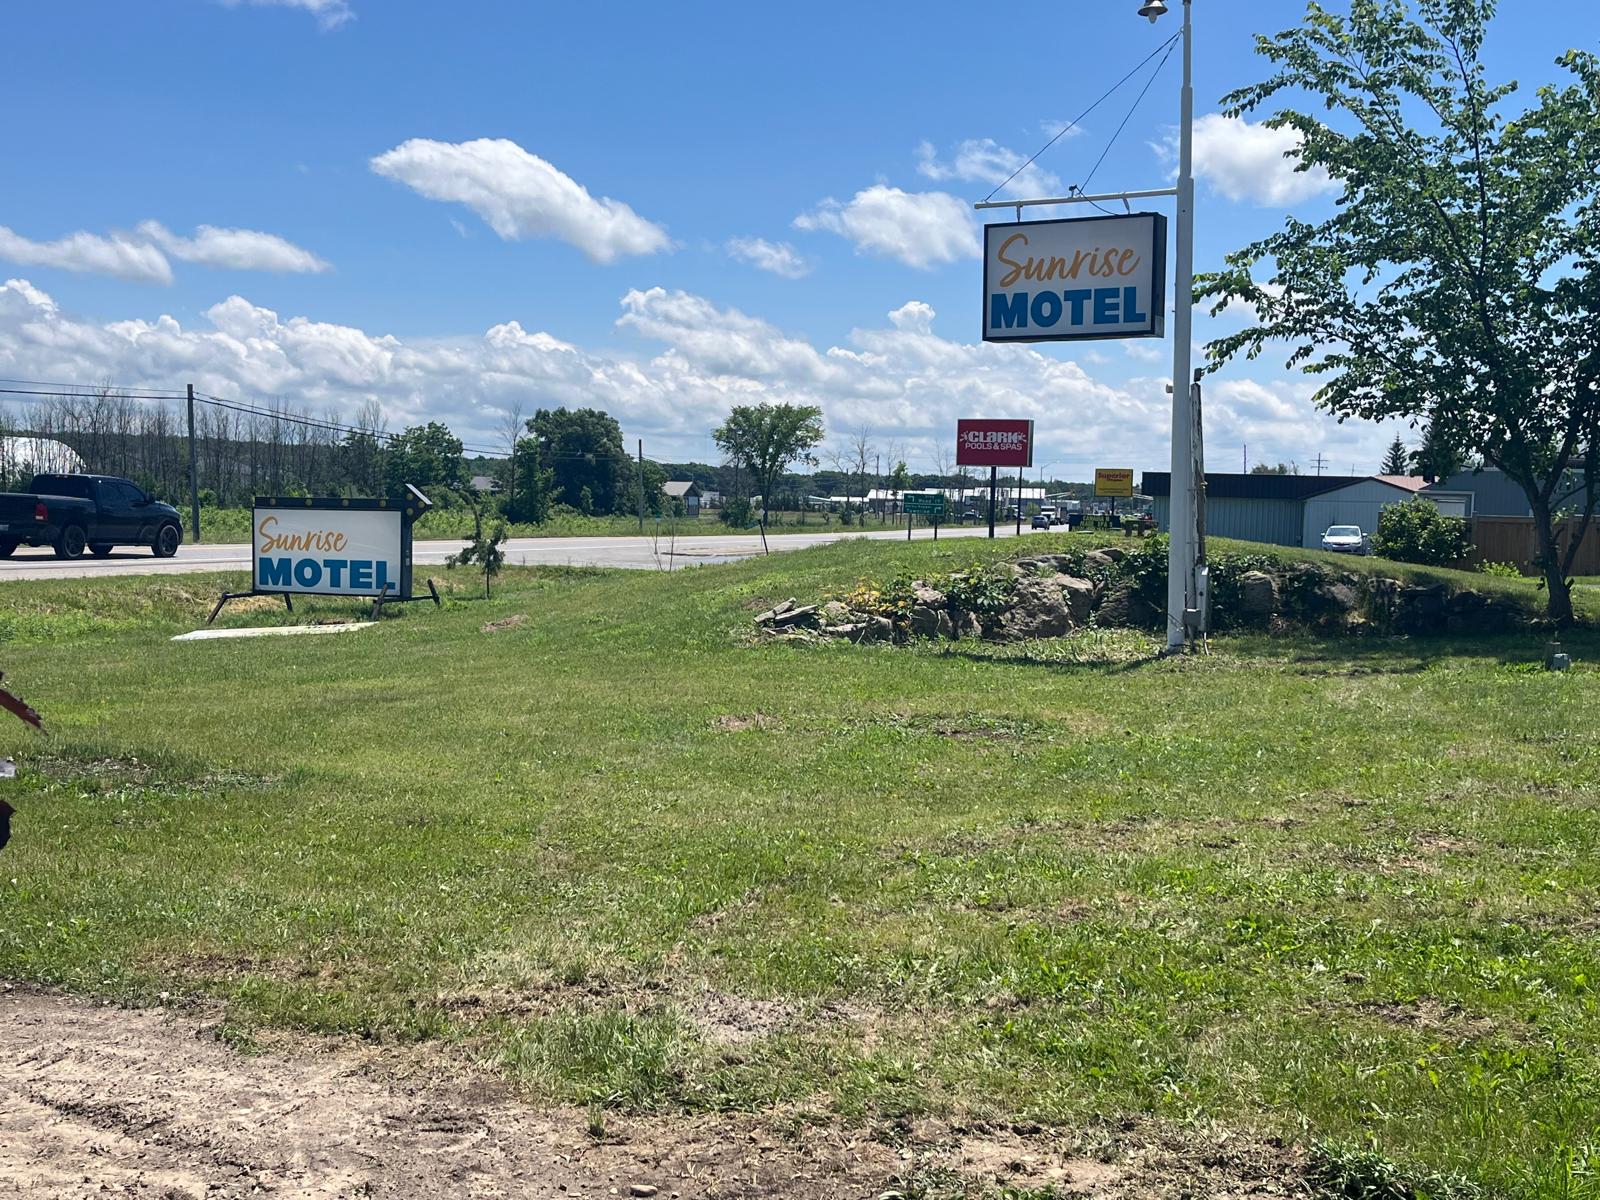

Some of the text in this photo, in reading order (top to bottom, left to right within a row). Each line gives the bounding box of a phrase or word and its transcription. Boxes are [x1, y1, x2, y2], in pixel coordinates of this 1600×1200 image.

[998, 233, 1140, 287] Sunrise
[990, 286, 1146, 329] MOTEL
[965, 442, 992, 450] POOLS
[259, 516, 348, 553] Sunrise
[259, 557, 396, 590] MOTEL
